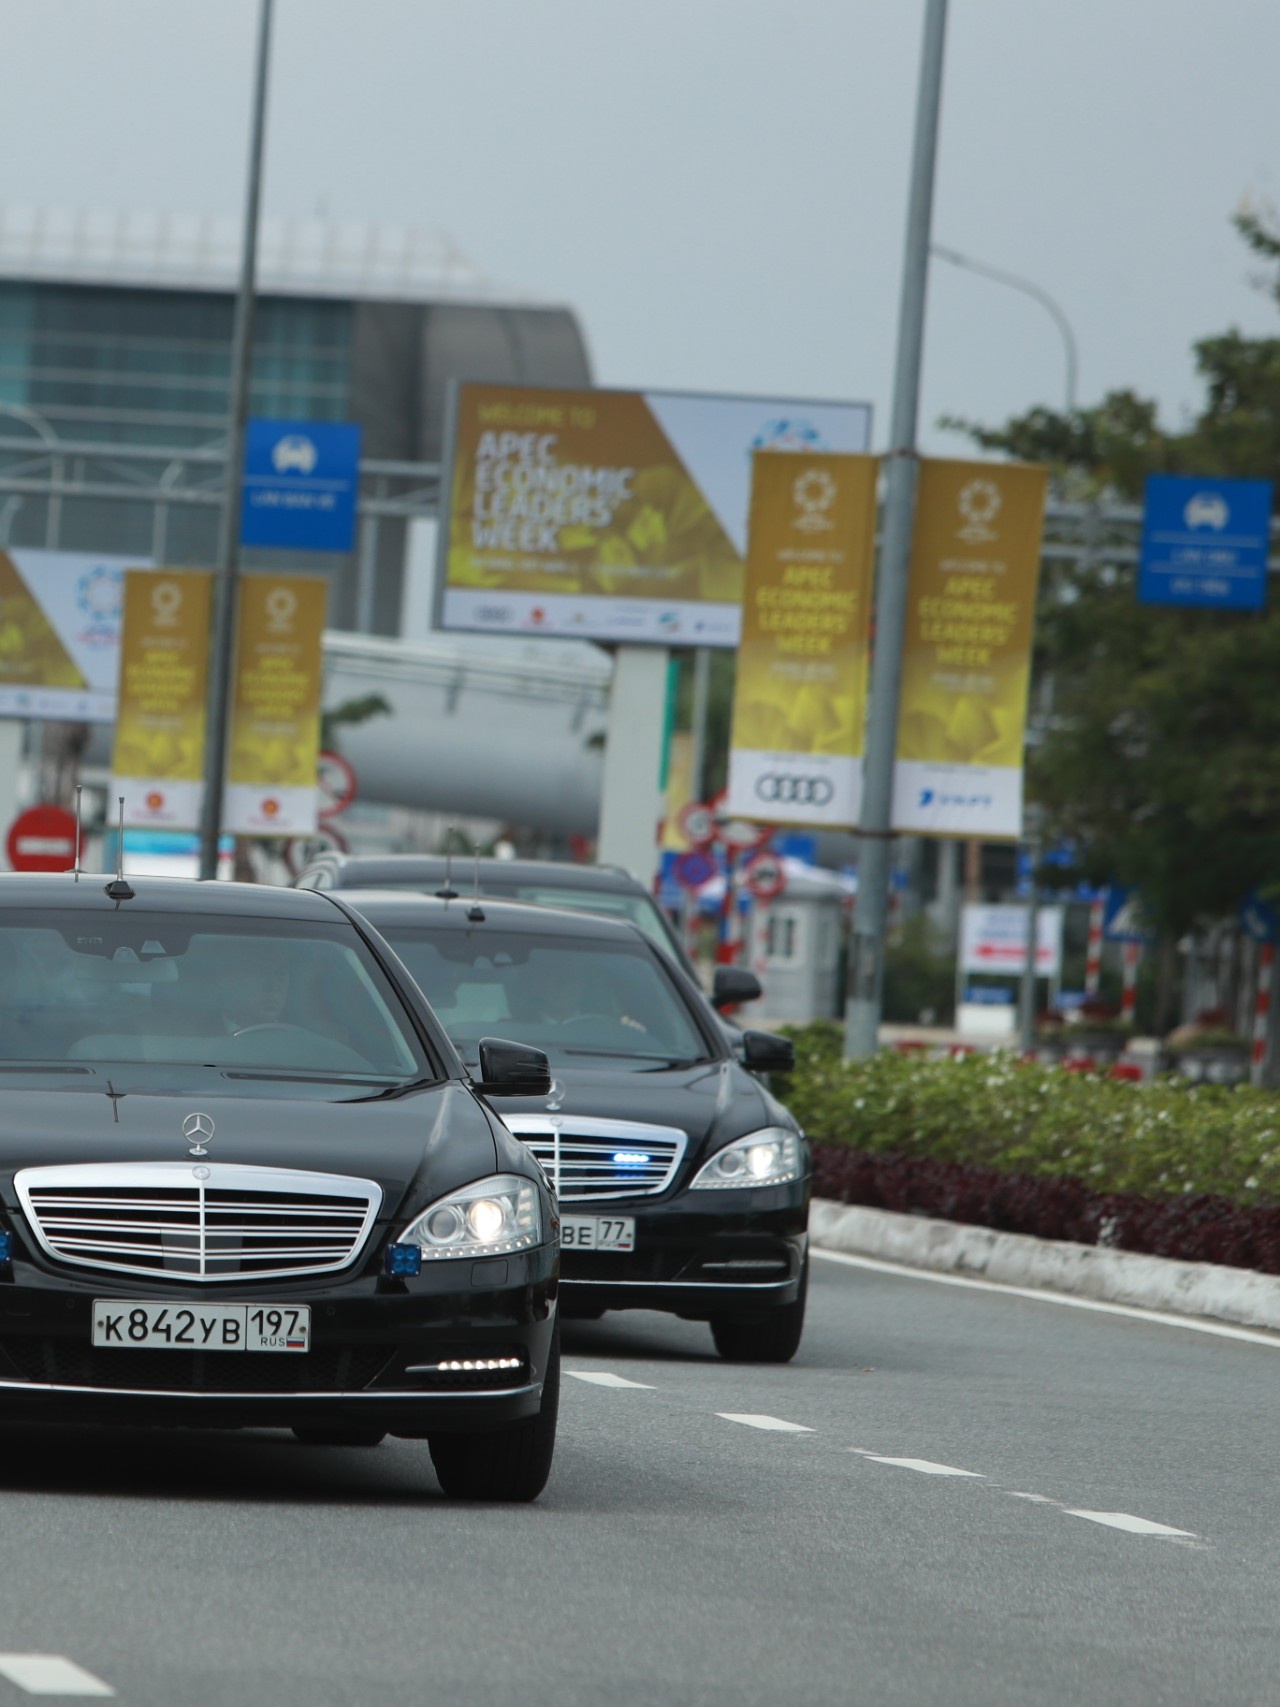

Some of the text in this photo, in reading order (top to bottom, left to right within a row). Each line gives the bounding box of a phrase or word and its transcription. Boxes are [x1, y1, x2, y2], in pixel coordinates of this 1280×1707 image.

[477, 431, 558, 460] APEC
[476, 462, 635, 500] ECONOMIC
[472, 521, 560, 552] WEEK
[601, 1221, 625, 1239] 77
[250, 1310, 299, 1337] 197
[260, 1337, 285, 1347] RUS
